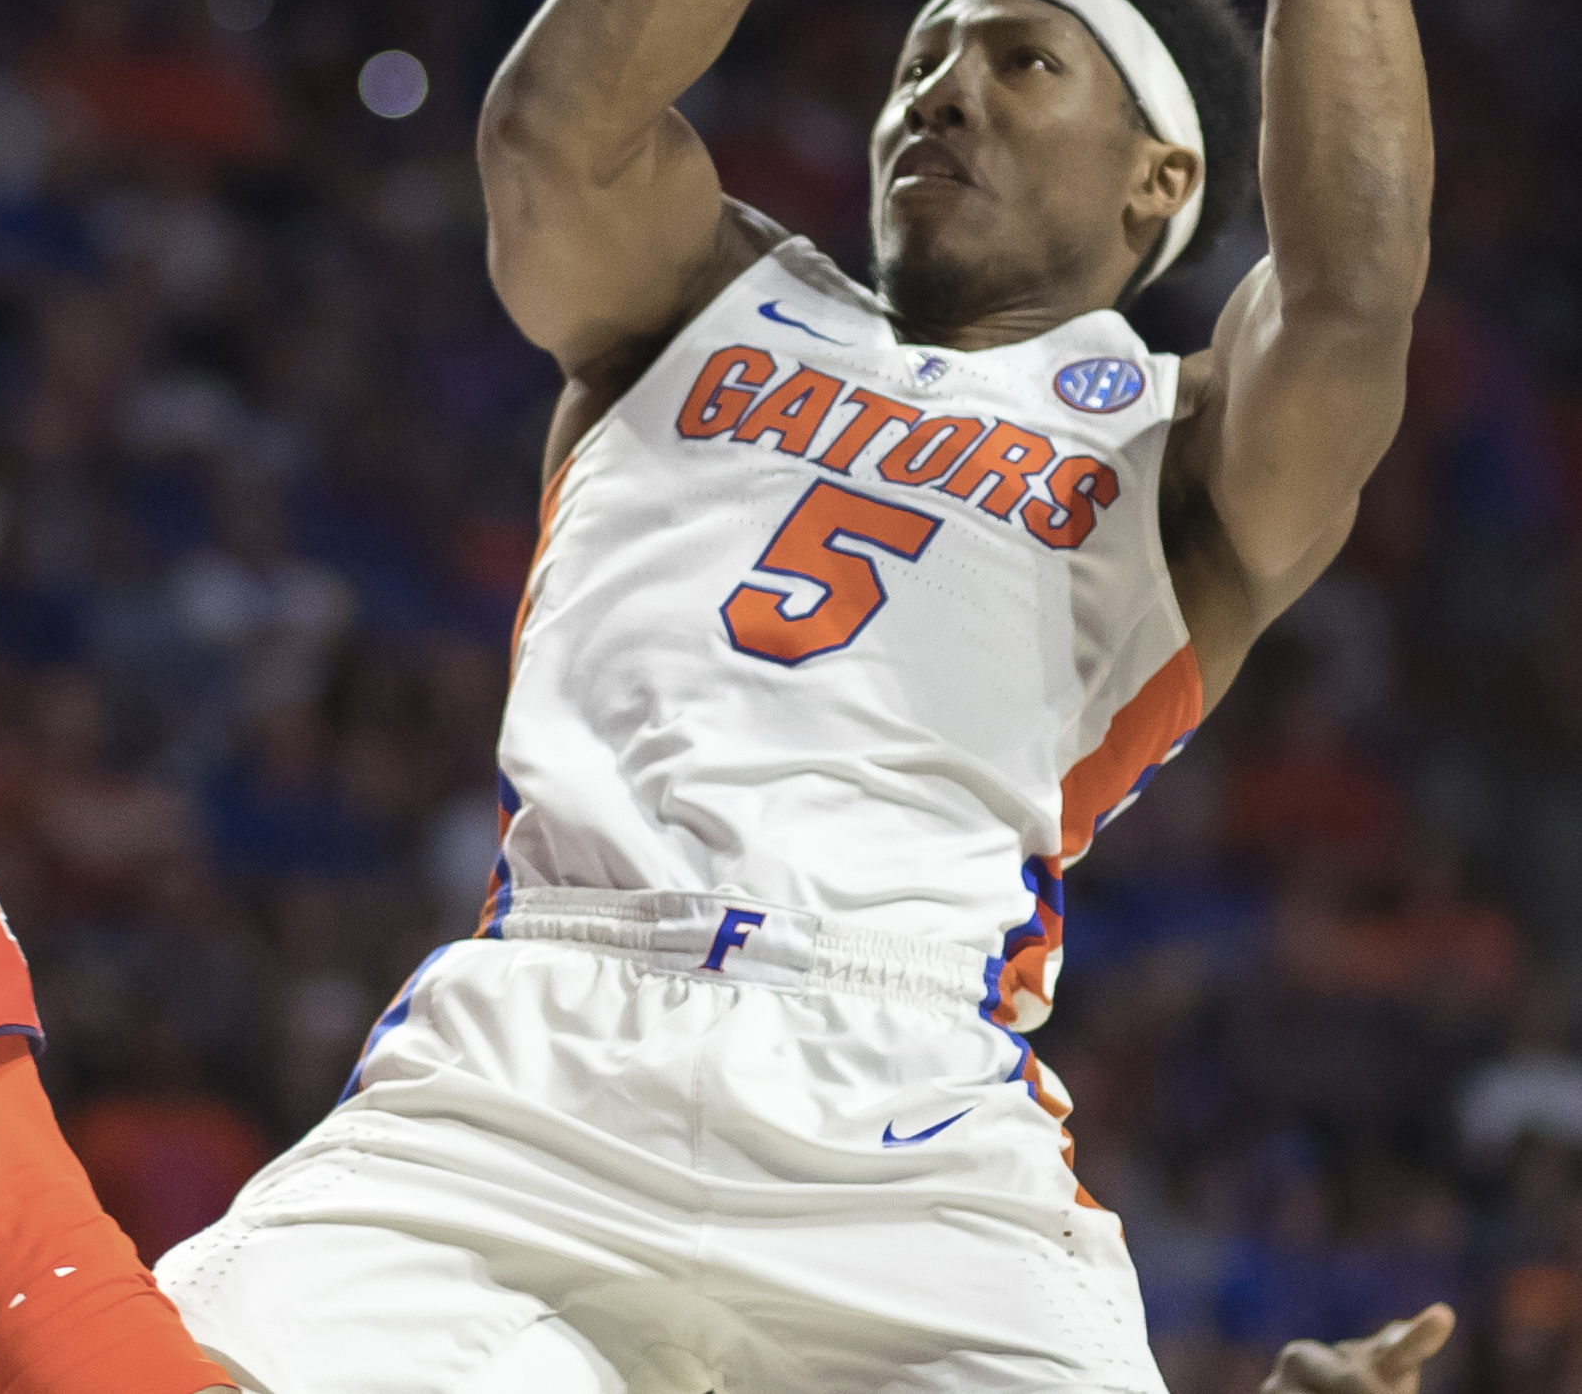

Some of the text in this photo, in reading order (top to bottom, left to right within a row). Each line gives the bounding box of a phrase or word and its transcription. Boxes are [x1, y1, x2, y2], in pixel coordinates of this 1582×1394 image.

[675, 344, 1120, 550] GATORS
[1059, 360, 1140, 409] SEC
[720, 477, 944, 667] 5
[699, 907, 767, 973] F
